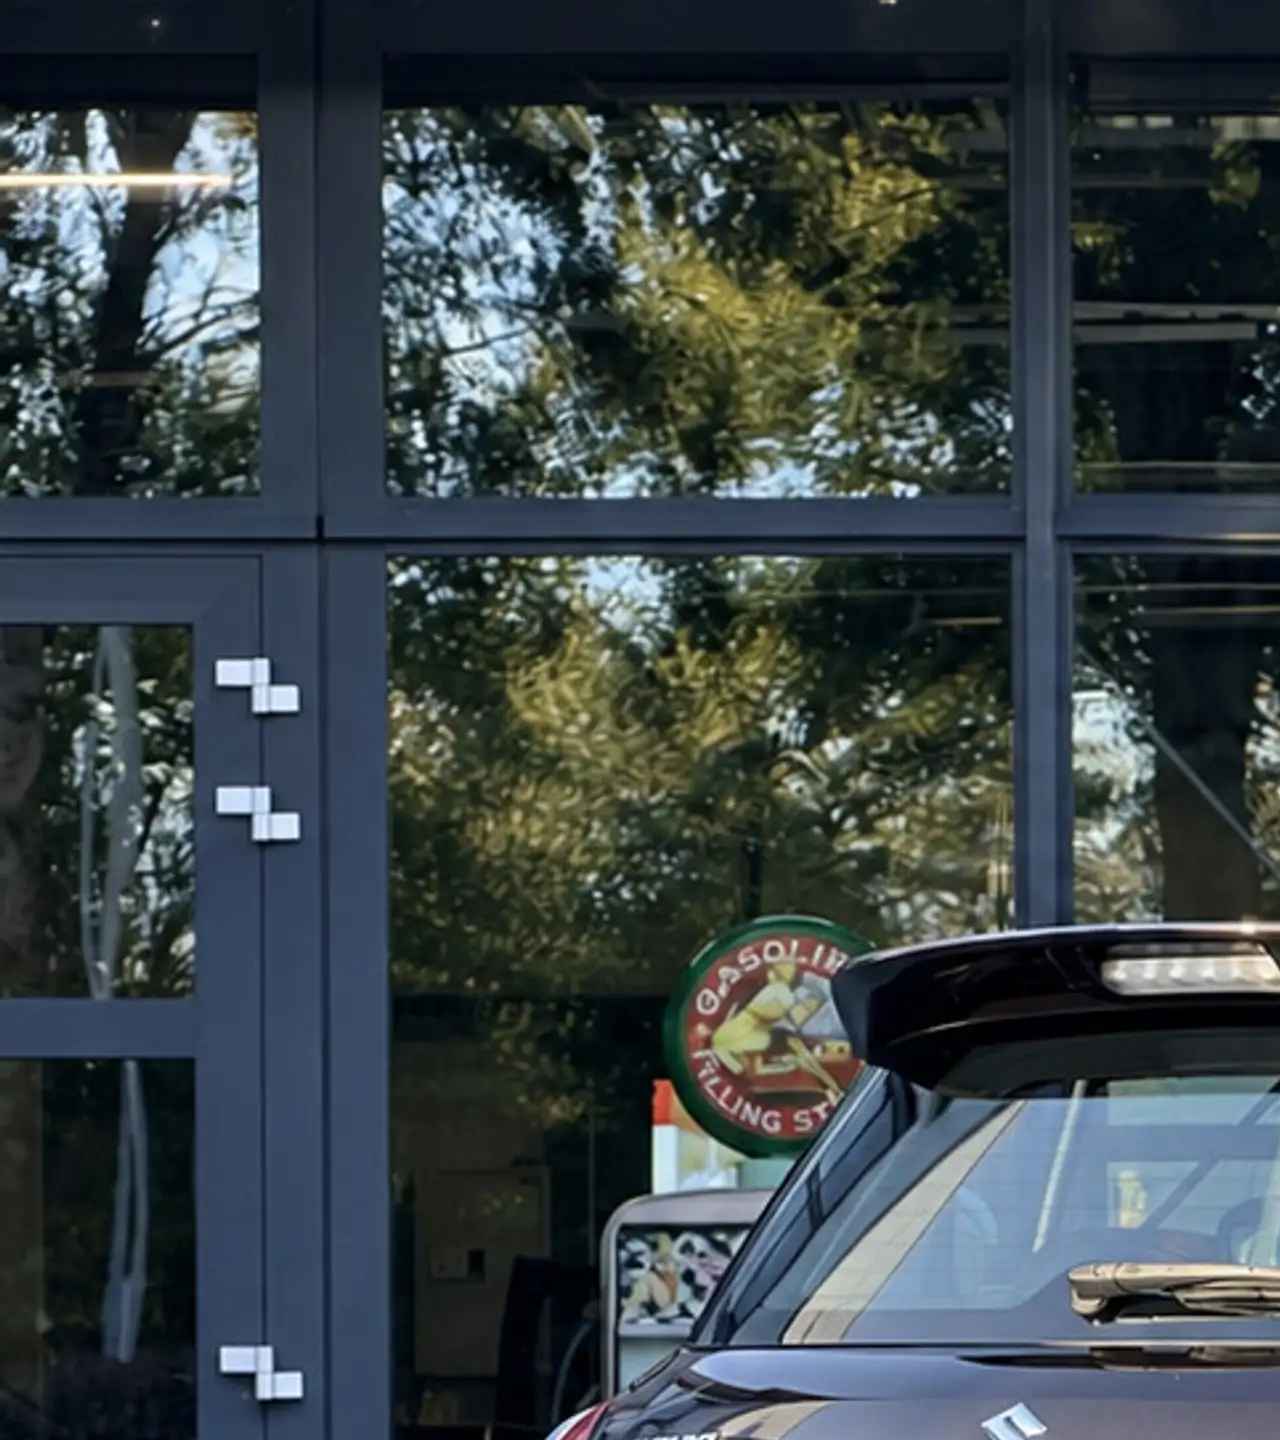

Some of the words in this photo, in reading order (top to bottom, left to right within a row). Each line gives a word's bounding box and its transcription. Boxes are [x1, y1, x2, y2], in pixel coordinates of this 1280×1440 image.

[695, 938, 849, 1016] GASOLIN
[692, 1049, 782, 1135] FILLING
[792, 1101, 829, 1132] ST
